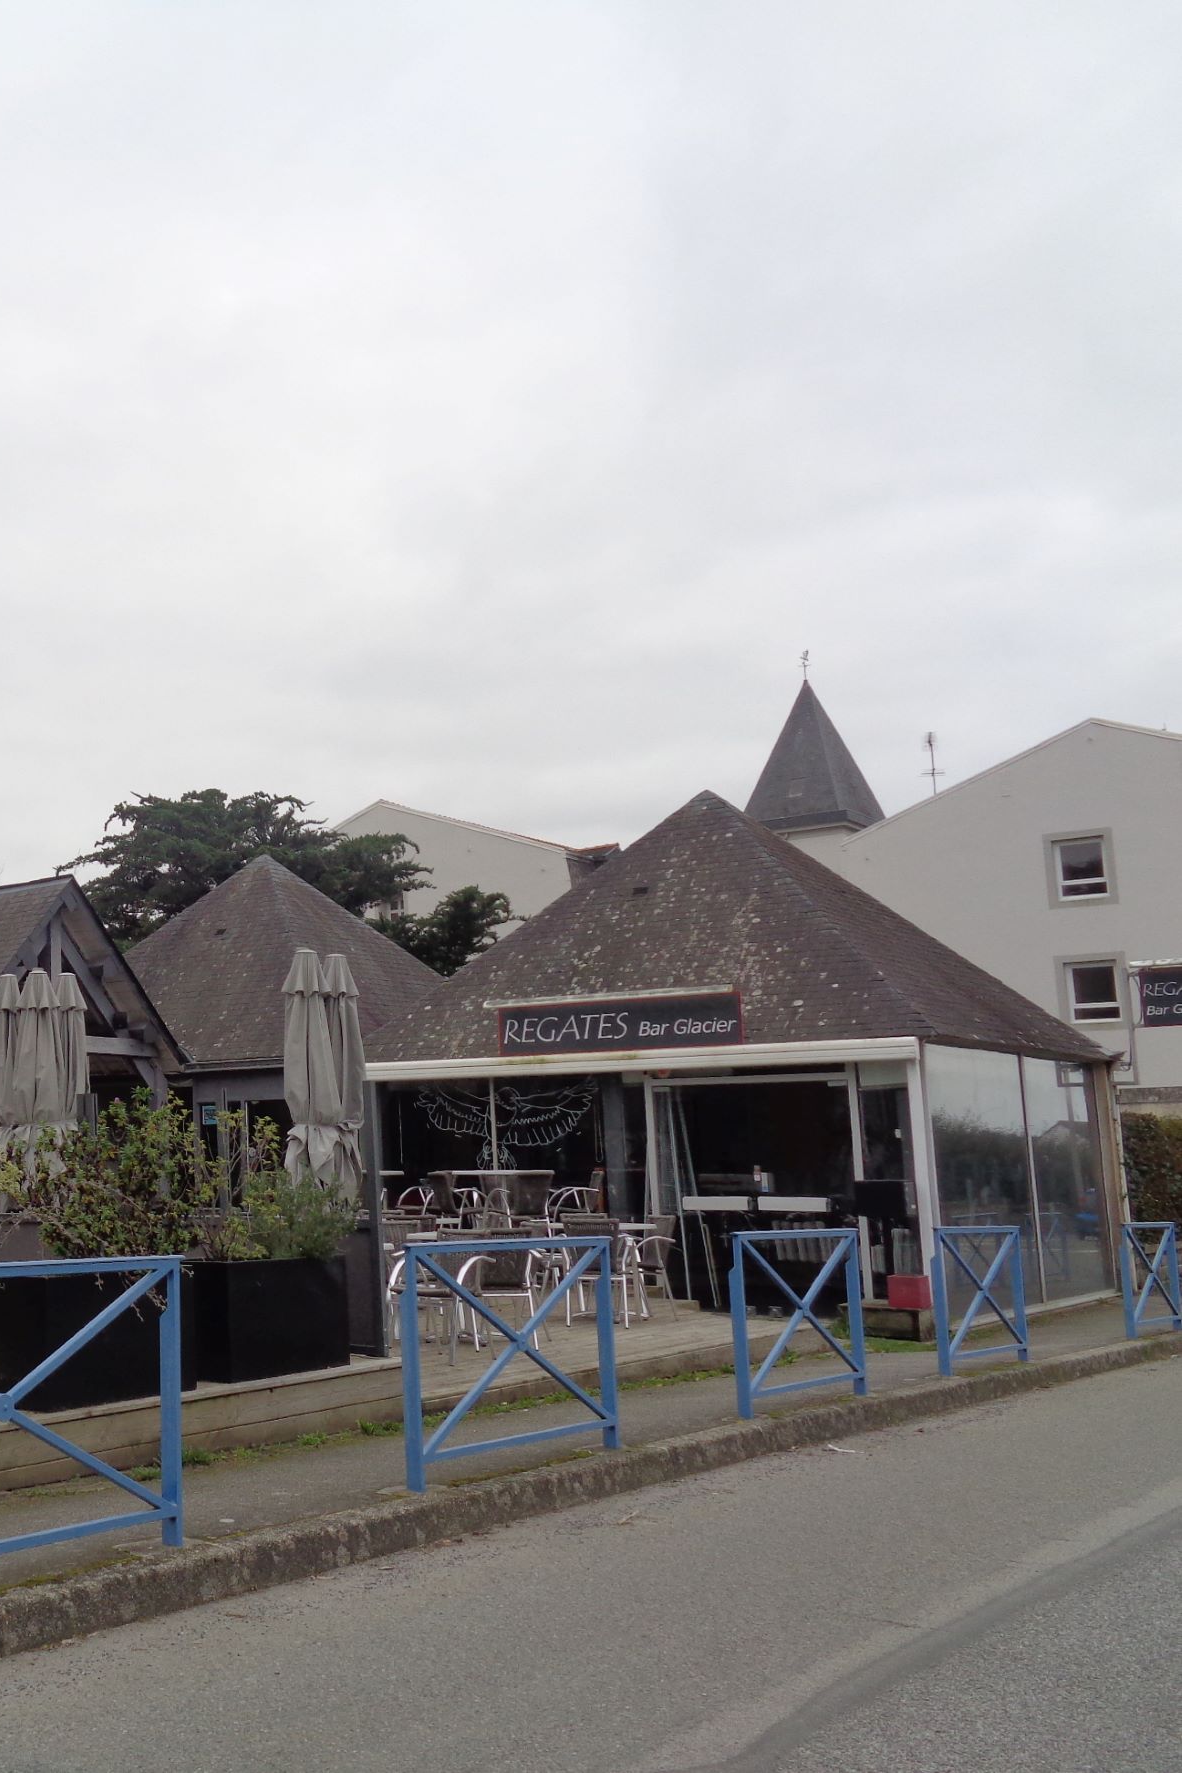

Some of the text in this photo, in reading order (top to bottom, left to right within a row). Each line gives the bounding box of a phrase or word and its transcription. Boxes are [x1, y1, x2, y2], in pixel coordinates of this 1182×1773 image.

[1146, 1005, 1170, 1016] Bar
[503, 1012, 738, 1045] REGATES Bar Glacier
